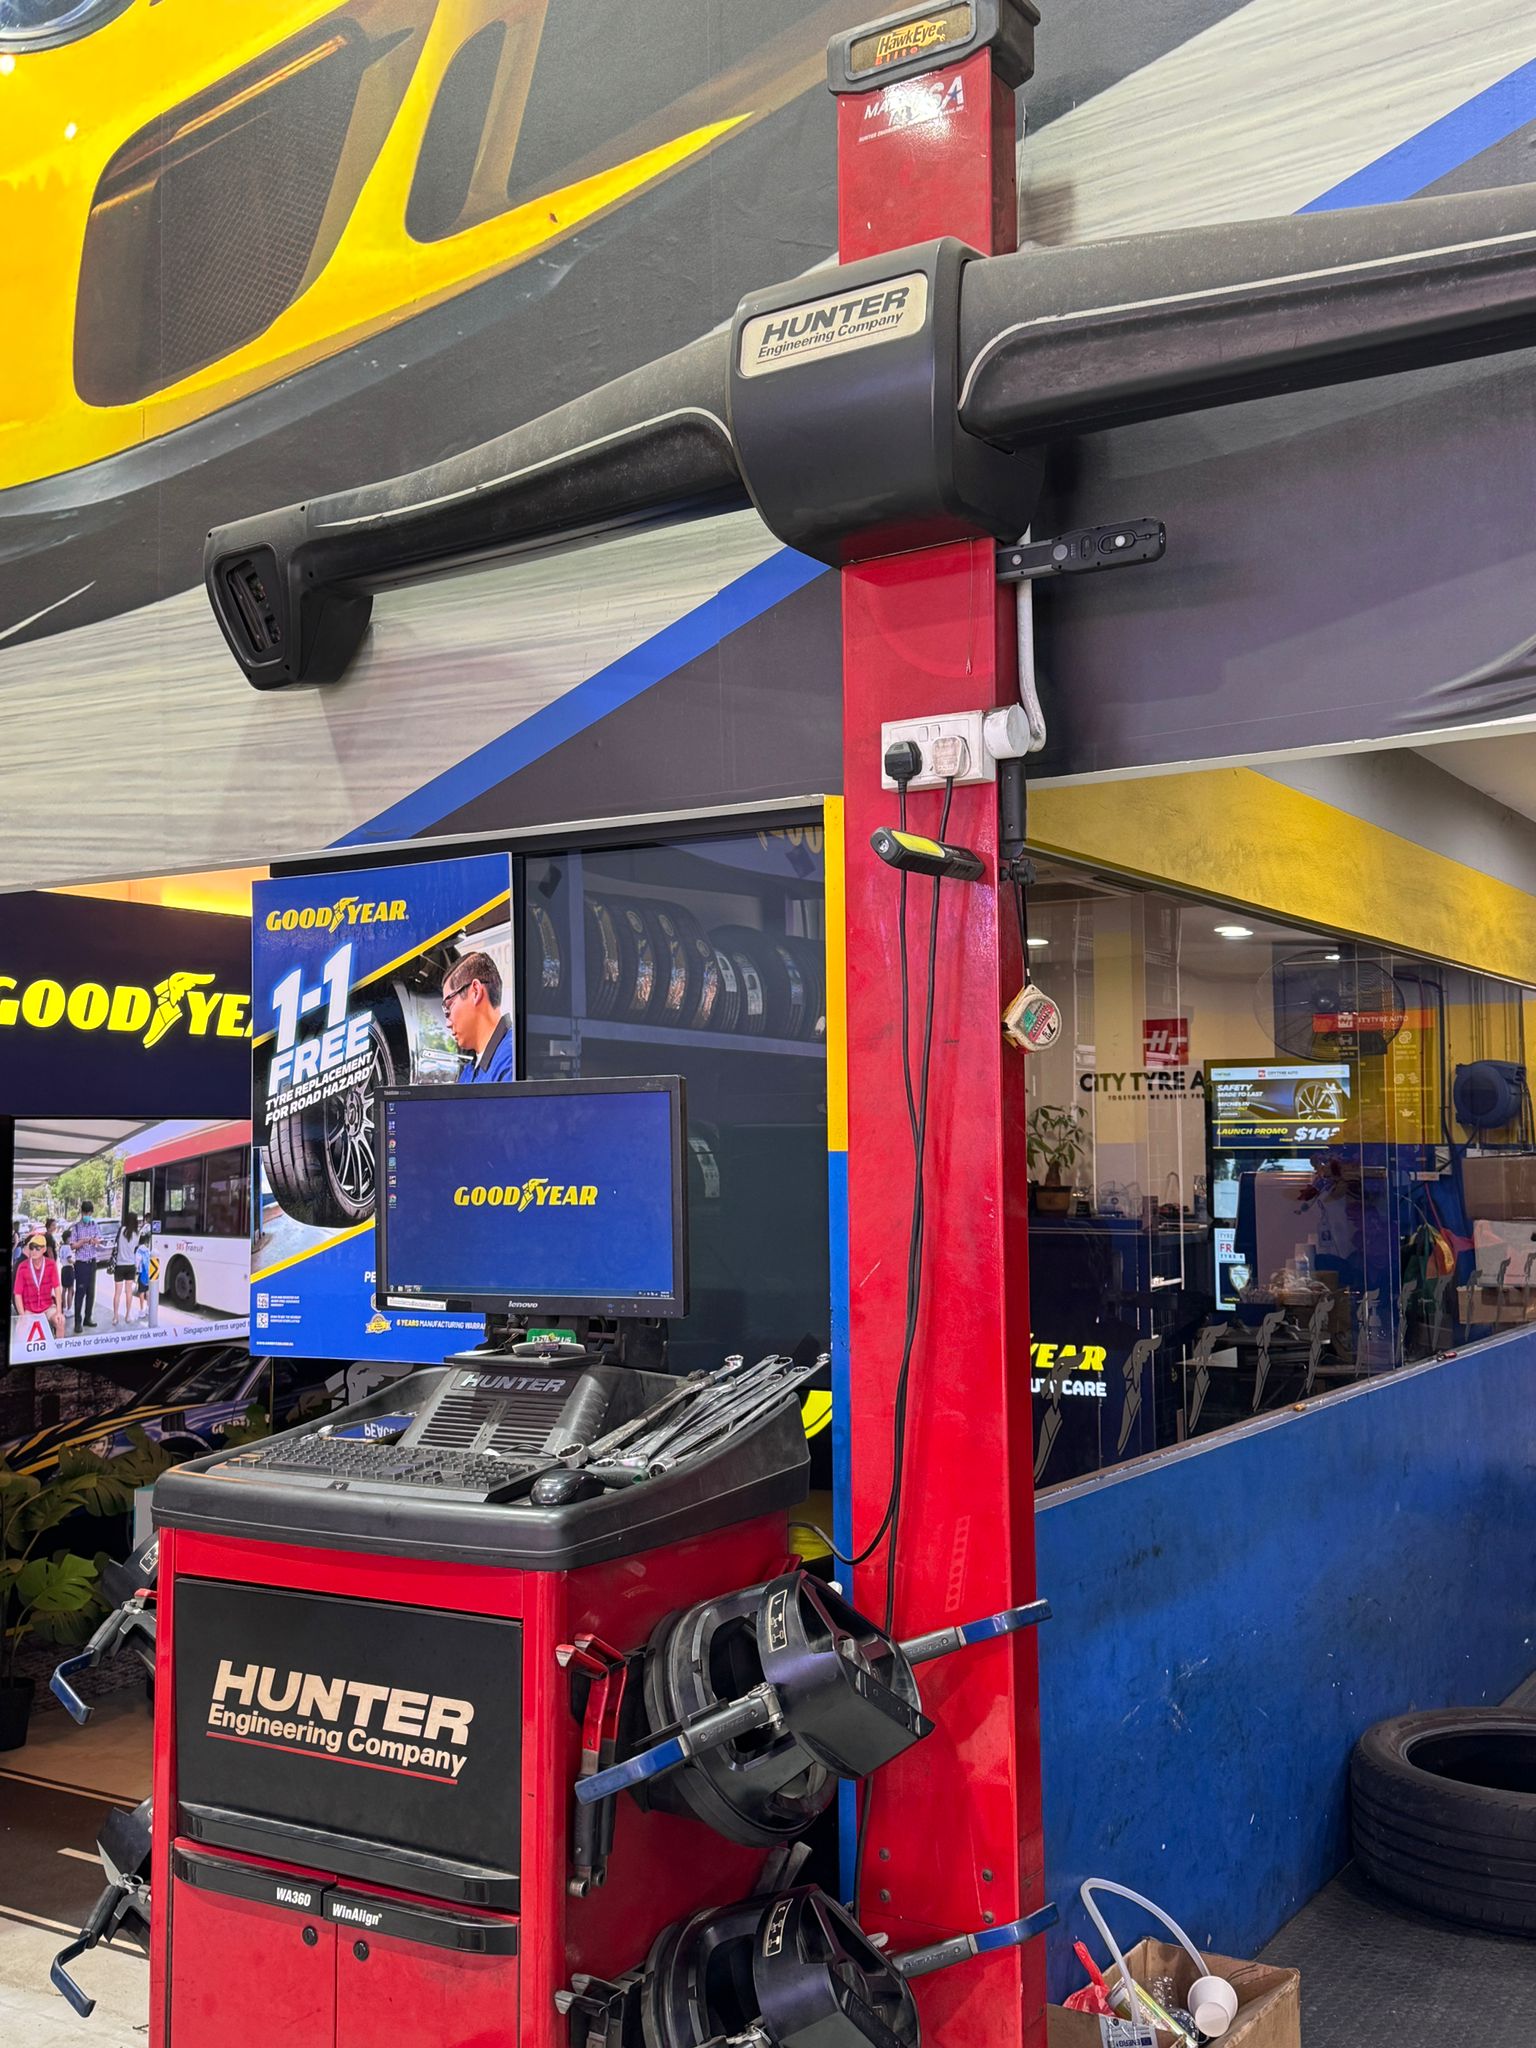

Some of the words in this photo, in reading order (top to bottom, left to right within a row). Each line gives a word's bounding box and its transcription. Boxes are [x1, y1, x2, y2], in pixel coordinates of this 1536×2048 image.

[879, 24, 937, 55] HawkEye
[762, 287, 910, 345] HUNTER
[758, 330, 835, 358] Engineering
[837, 312, 904, 336] Company
[266, 898, 407, 931] GOODYEAR
[0, 976, 252, 1038] GOODYE
[273, 943, 352, 1053] 1-1
[268, 1011, 372, 1097] FREE
[265, 1086, 294, 1112] TYRE
[293, 1052, 373, 1100] REPLACEMENT
[1080, 1072, 1126, 1092] CITY
[1130, 1071, 1185, 1091] TYRE
[1217, 1084, 1253, 1092] SAFETY
[265, 1105, 289, 1126] FOR
[289, 1091, 323, 1118] ROAD
[454, 1184, 598, 1206] GOODYEAR
[508, 1300, 538, 1309] lenovo
[183, 1325, 214, 1335] Singapore
[214, 1322, 229, 1331] firms
[230, 1320, 247, 1330] urged
[401, 1319, 419, 1328] YEARS
[419, 1320, 464, 1329] MANUFACTURING
[26, 1341, 46, 1353] cna
[64, 1340, 81, 1348] Prize
[83, 1338, 93, 1346] for
[93, 1335, 120, 1345] drinking
[120, 1333, 138, 1341] water
[139, 1331, 151, 1340] risk
[152, 1330, 168, 1338] work
[460, 1373, 567, 1393] HUNTER
[1062, 1379, 1107, 1397] CARE
[212, 1659, 475, 1745] HUNTER
[208, 1702, 343, 1753] Engineering
[347, 1728, 467, 1777] Company
[276, 1887, 312, 1907] WA360
[332, 1903, 380, 1926] WinAlign
